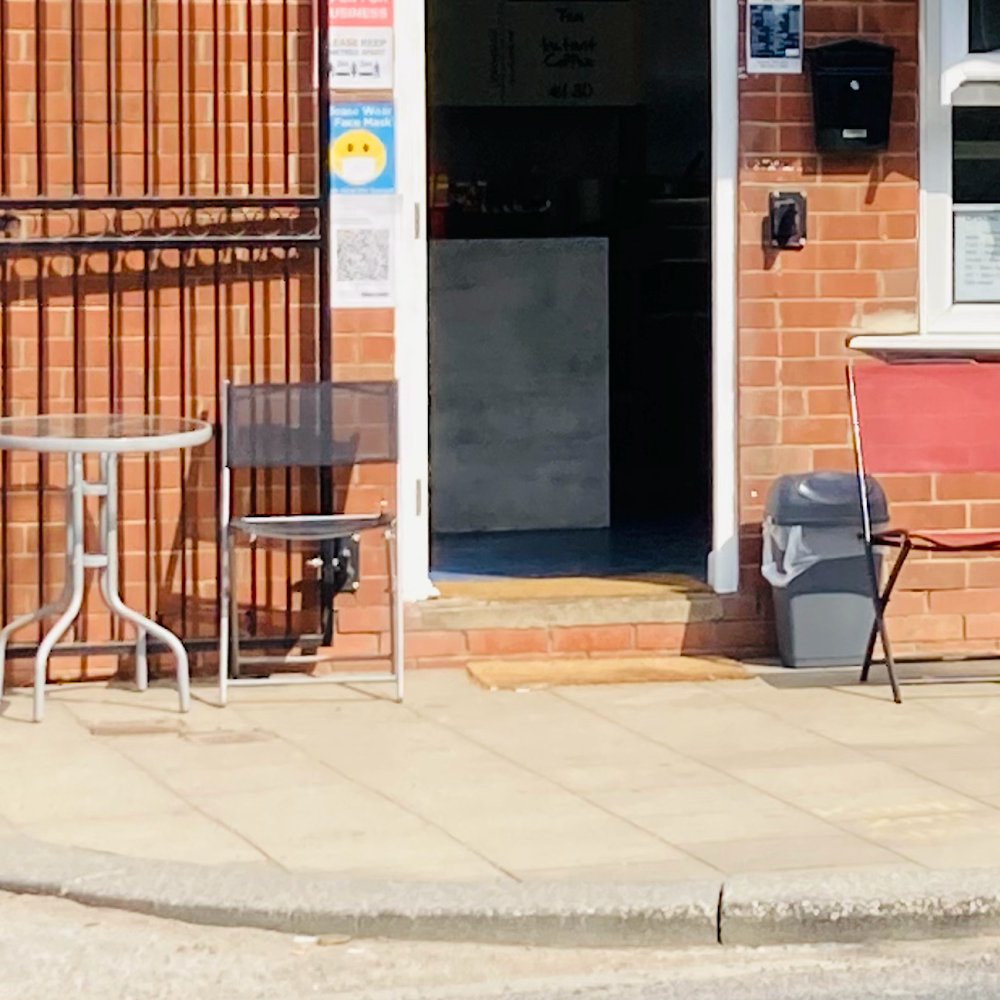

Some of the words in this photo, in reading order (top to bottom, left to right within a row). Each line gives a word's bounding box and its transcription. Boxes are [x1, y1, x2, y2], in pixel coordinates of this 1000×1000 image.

[329, 7, 388, 19] USINESS
[332, 38, 358, 47] EASE
[329, 105, 360, 116] lease
[362, 105, 392, 116] Wear
[334, 117, 361, 128] Face
[363, 117, 392, 128] Mask
